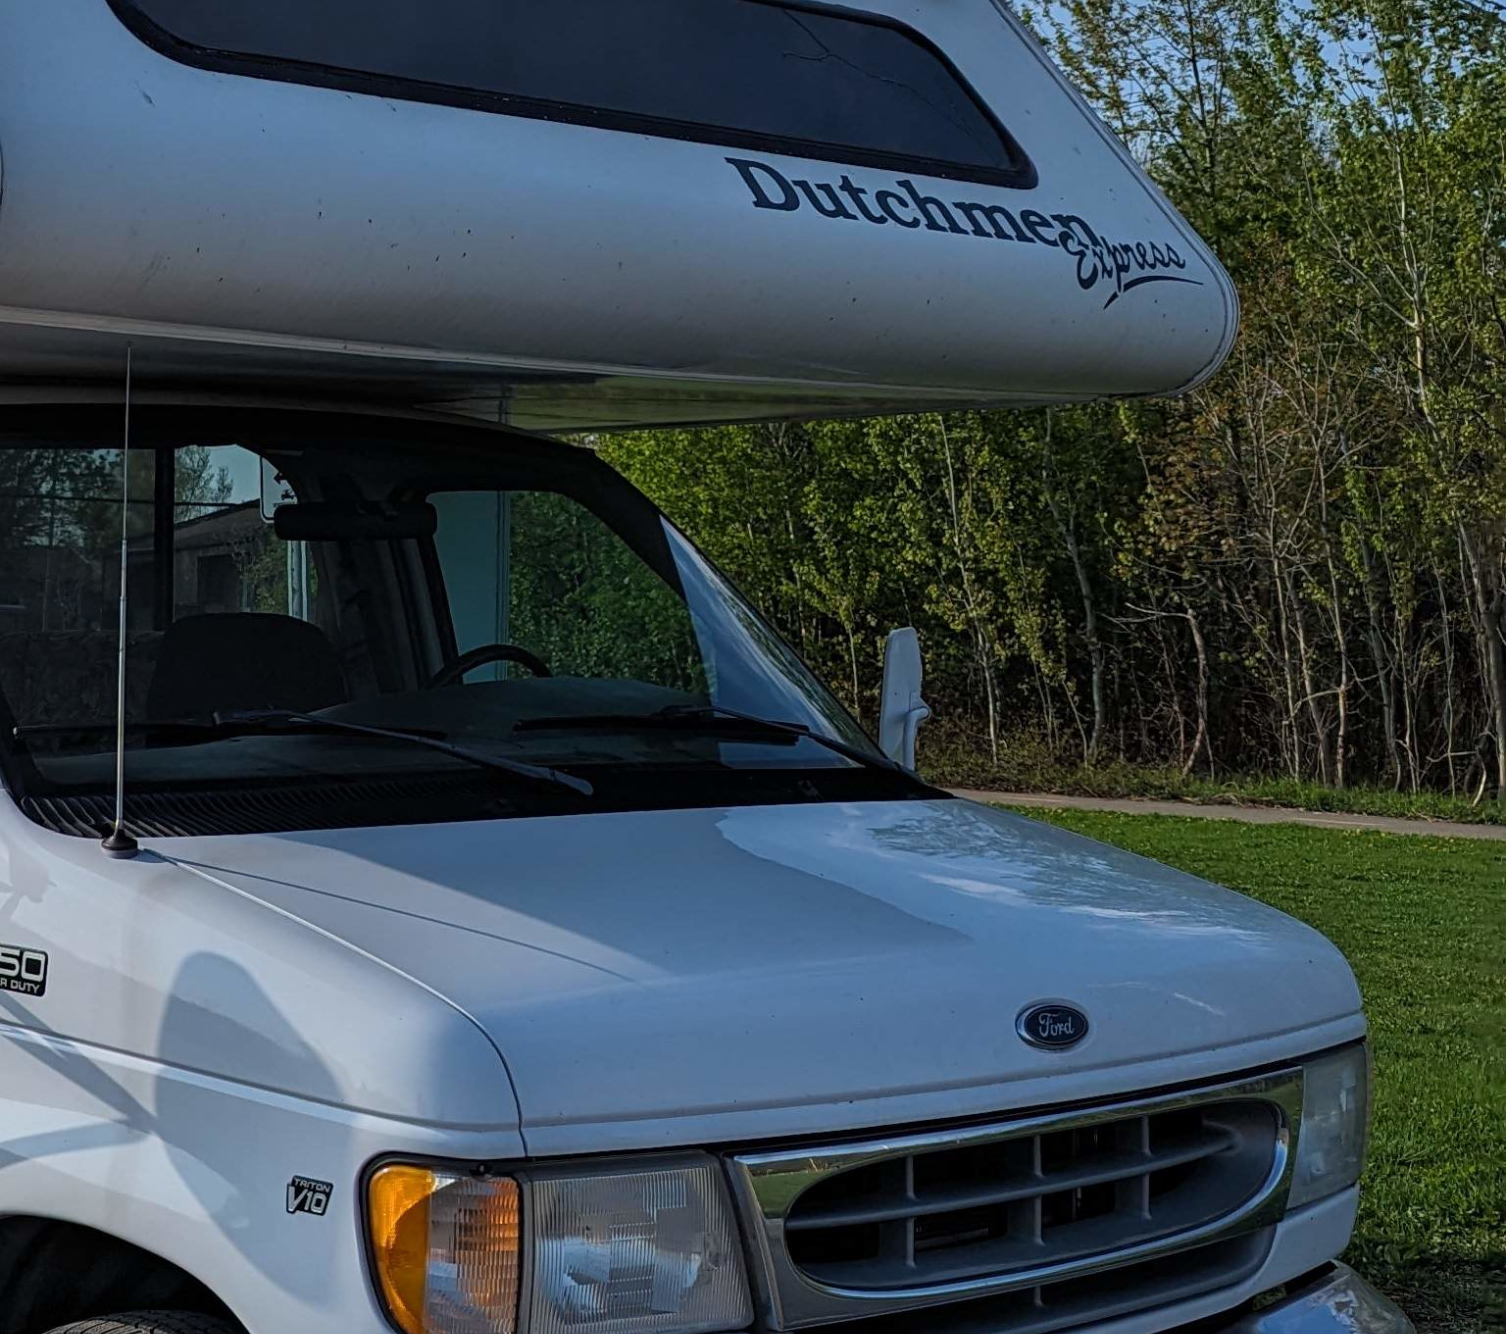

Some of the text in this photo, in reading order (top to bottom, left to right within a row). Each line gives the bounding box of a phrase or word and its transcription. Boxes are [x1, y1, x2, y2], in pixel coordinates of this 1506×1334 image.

[724, 157, 1100, 249] Dutchmen
[1059, 230, 1186, 293] Express
[10, 979, 40, 994] DUTY
[1038, 1012, 1075, 1037] Ford
[294, 1178, 331, 1193] TRITON
[288, 1186, 327, 1214] V10
